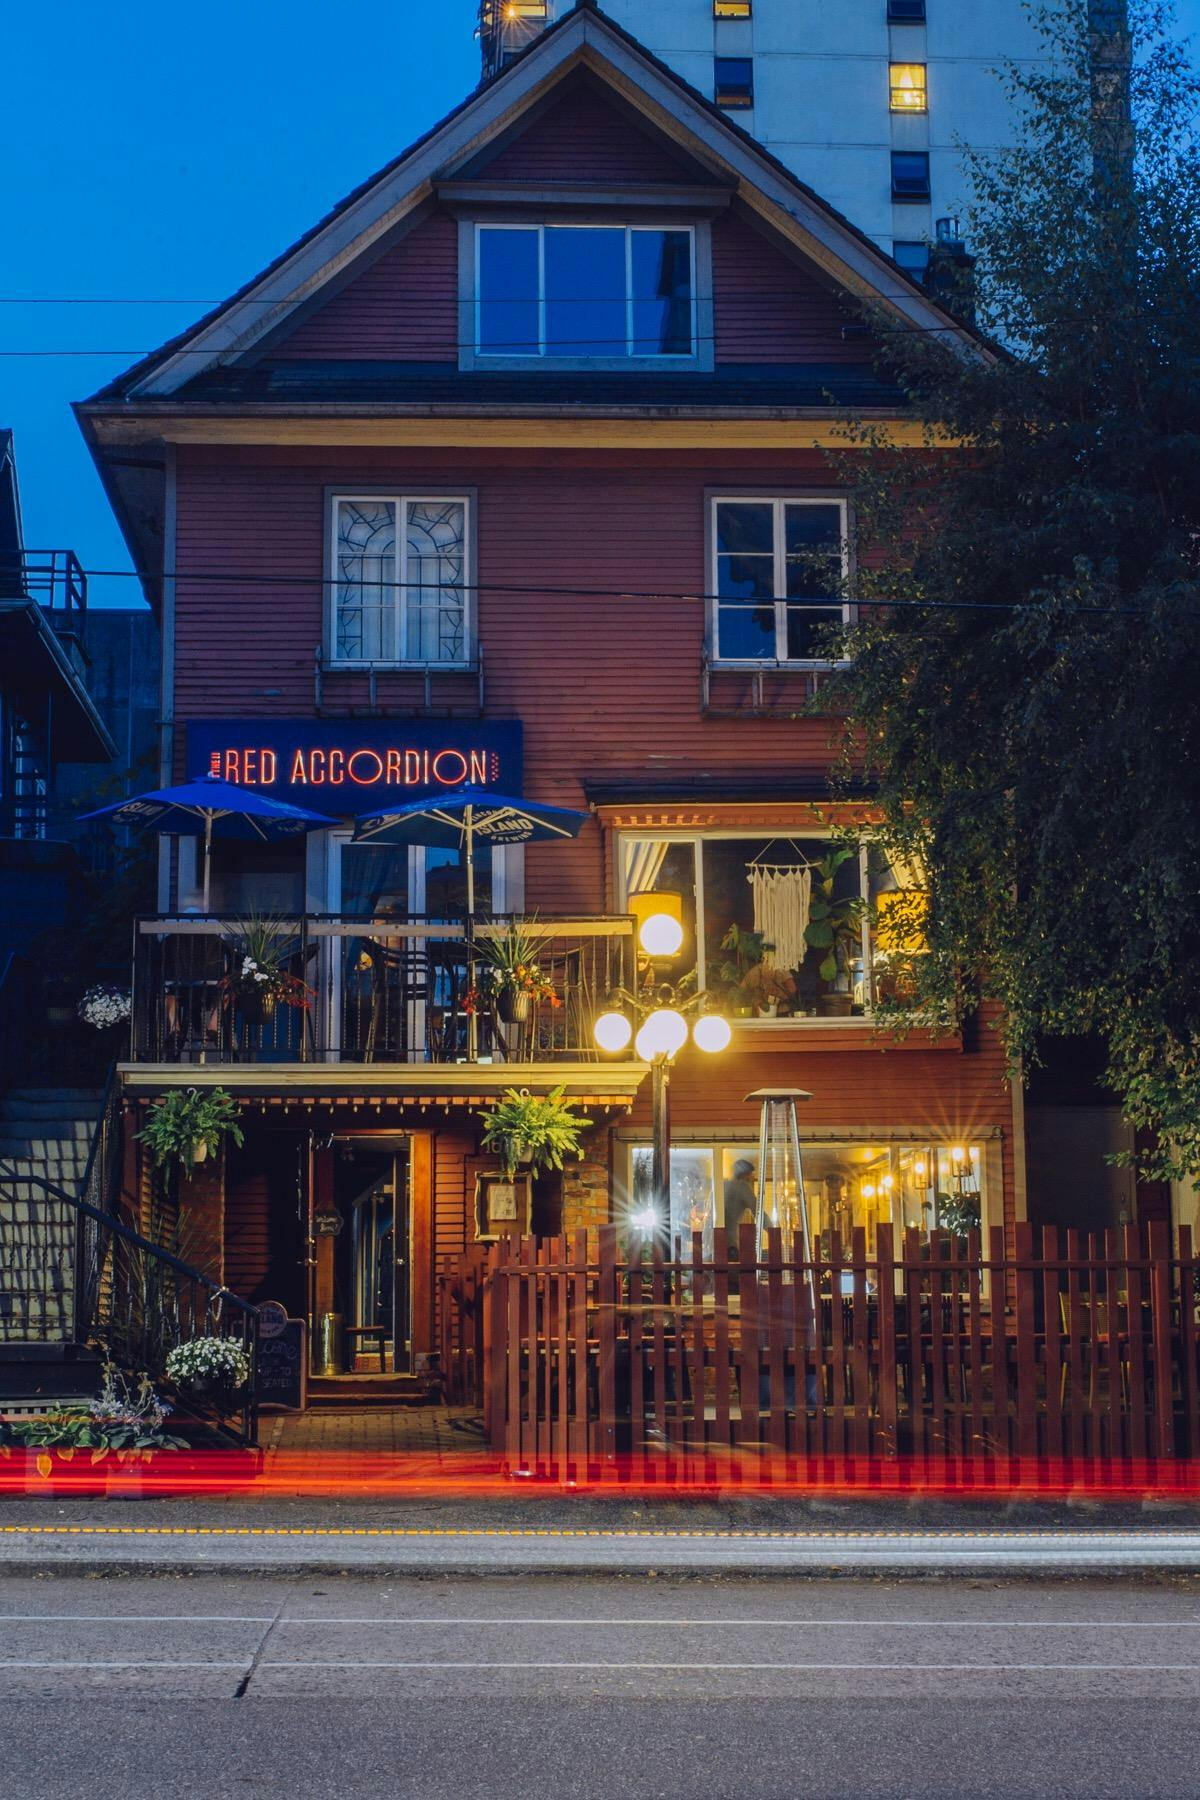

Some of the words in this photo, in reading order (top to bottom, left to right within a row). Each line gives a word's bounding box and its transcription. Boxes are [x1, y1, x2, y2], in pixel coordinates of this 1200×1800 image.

[226, 750, 275, 784] RED
[291, 750, 486, 784] ACCORDION
[476, 819, 534, 836] ISLAND
